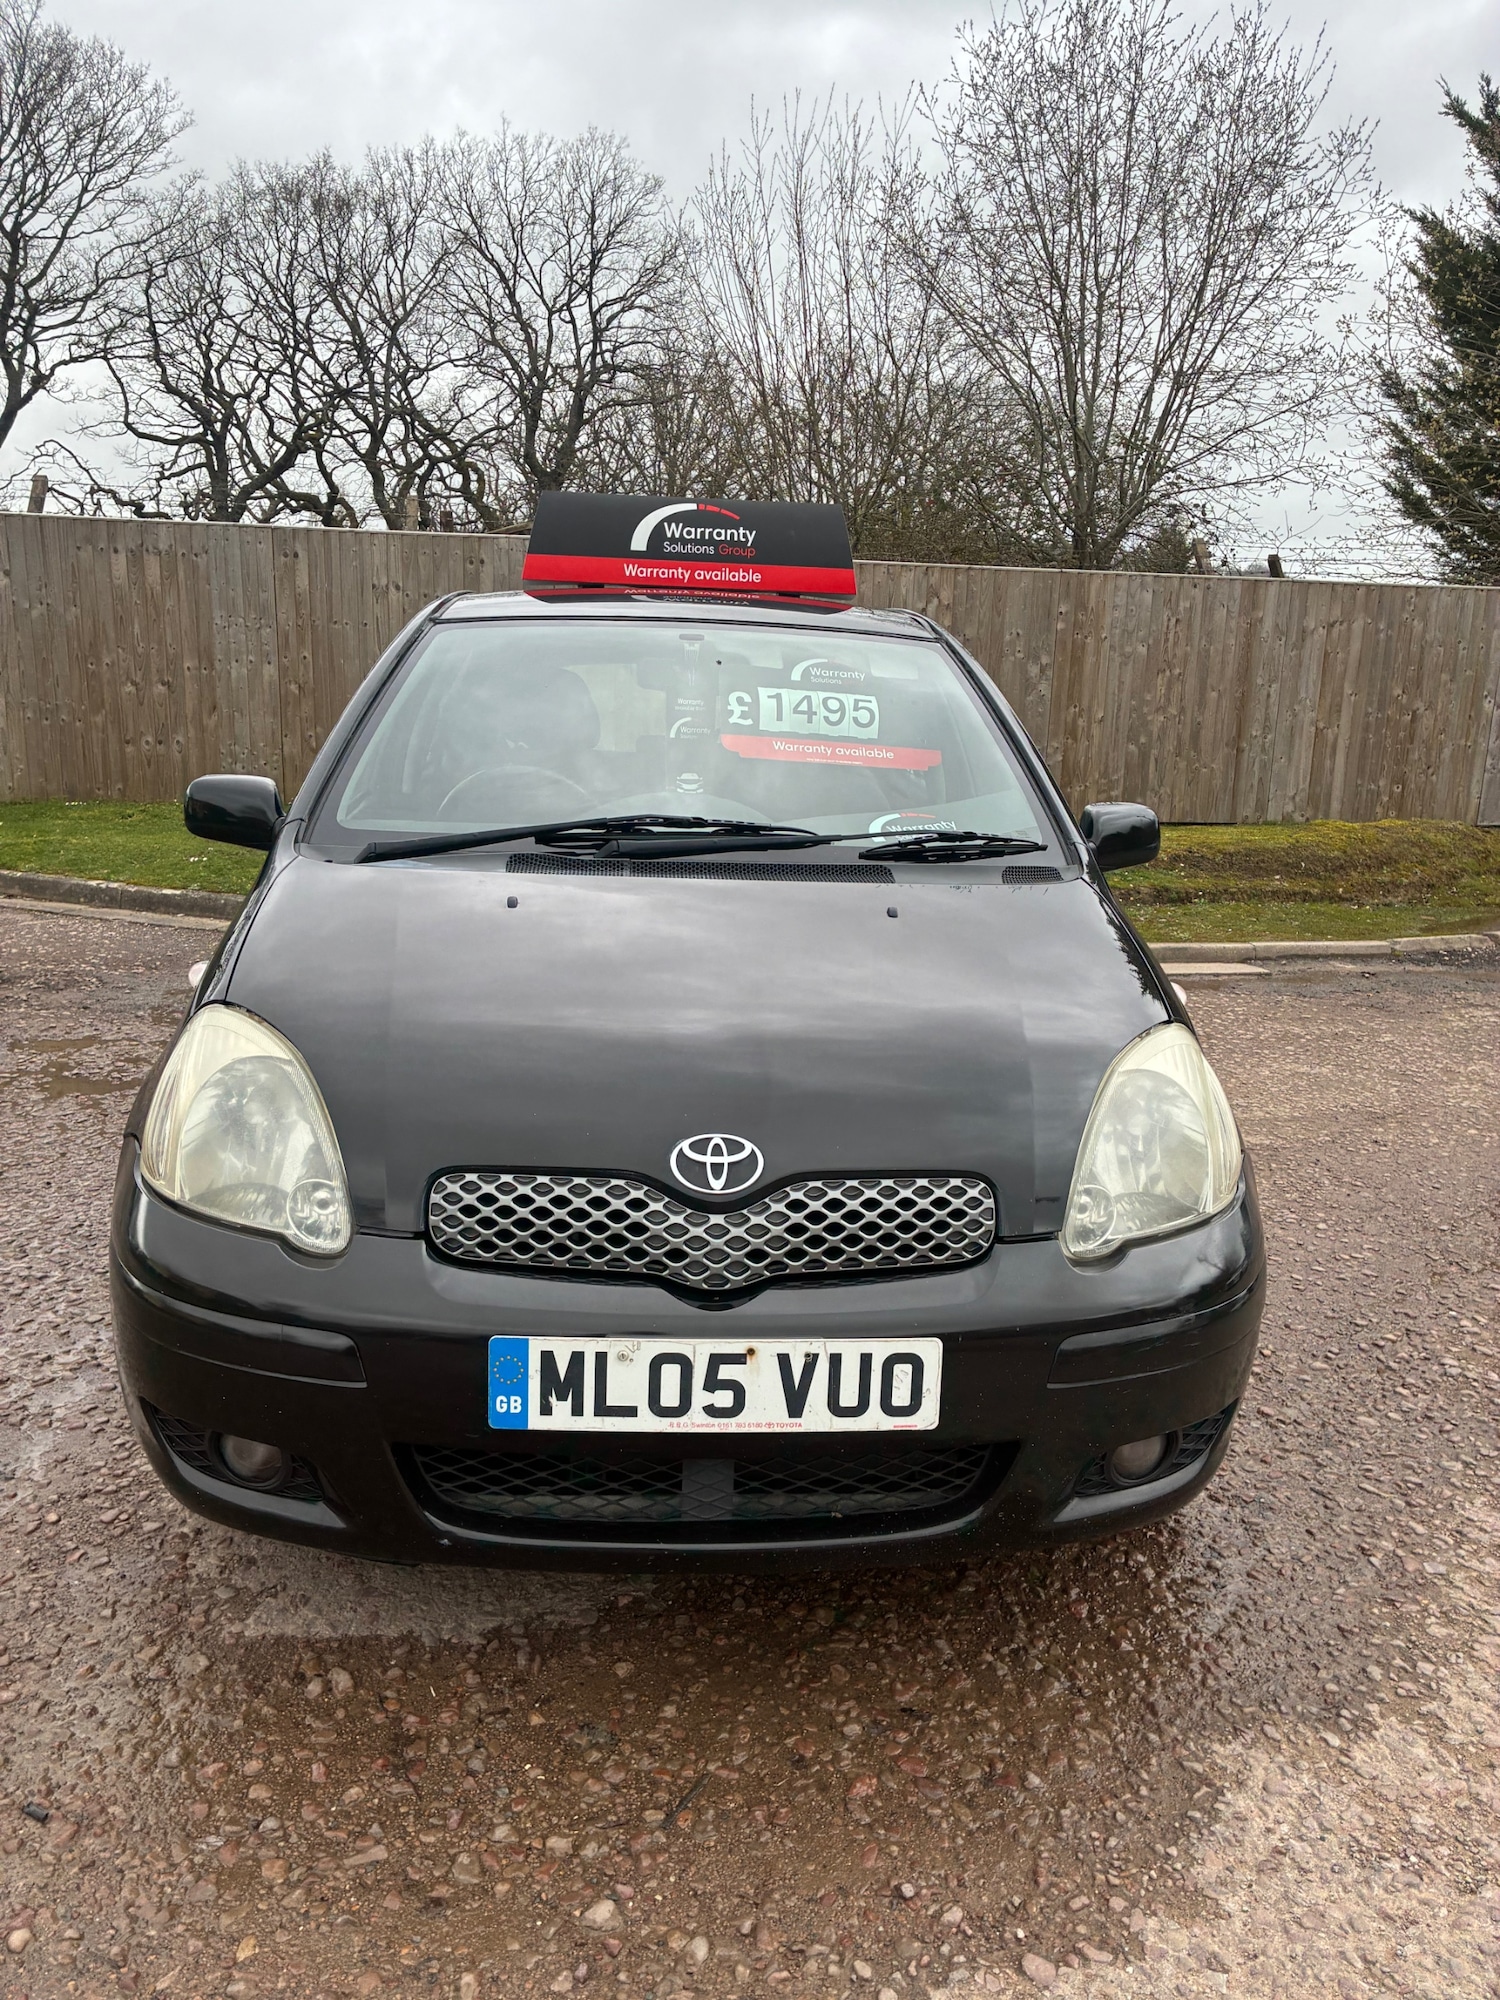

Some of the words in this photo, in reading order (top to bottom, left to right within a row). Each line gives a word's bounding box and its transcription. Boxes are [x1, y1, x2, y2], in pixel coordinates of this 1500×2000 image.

[663, 521, 757, 547] Warranty
[663, 541, 715, 555] Solutions
[718, 543, 756, 559] Group
[623, 563, 691, 584] Warranty
[694, 567, 762, 583] available
[809, 666, 866, 682] Warranty
[810, 676, 842, 685] Solutions
[727, 691, 876, 729] £1495
[680, 725, 711, 736] Warranty
[772, 740, 832, 756] Warranty
[835, 746, 895, 760] available
[495, 1395, 522, 1414] GB
